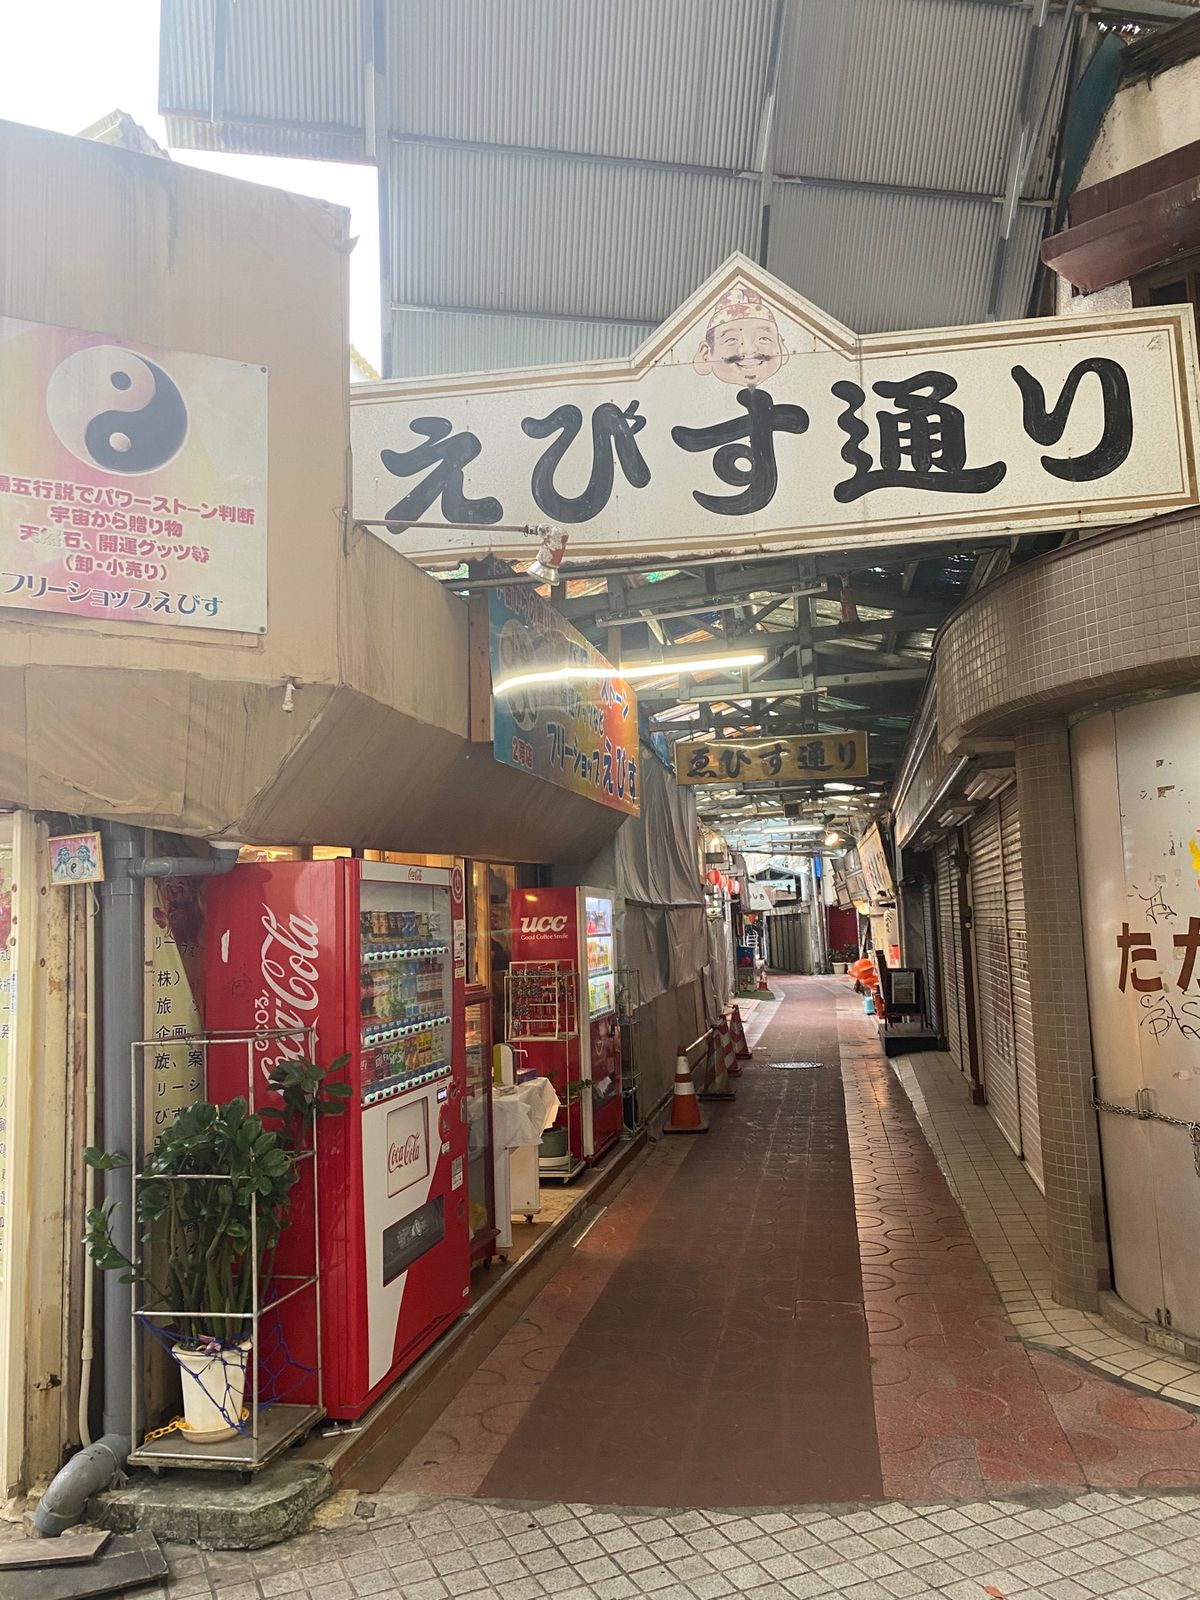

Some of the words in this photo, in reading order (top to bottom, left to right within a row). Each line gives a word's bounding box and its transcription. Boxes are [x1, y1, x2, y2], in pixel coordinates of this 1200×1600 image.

[380, 357, 1133, 532] えびす通り
[50, 505, 183, 538] 宇宙から贈り物
[20, 524, 210, 563] 天石、開運グッツ等
[1, 572, 223, 617] フリーショップえびす
[387, 1132, 421, 1174] Coca-Cola
